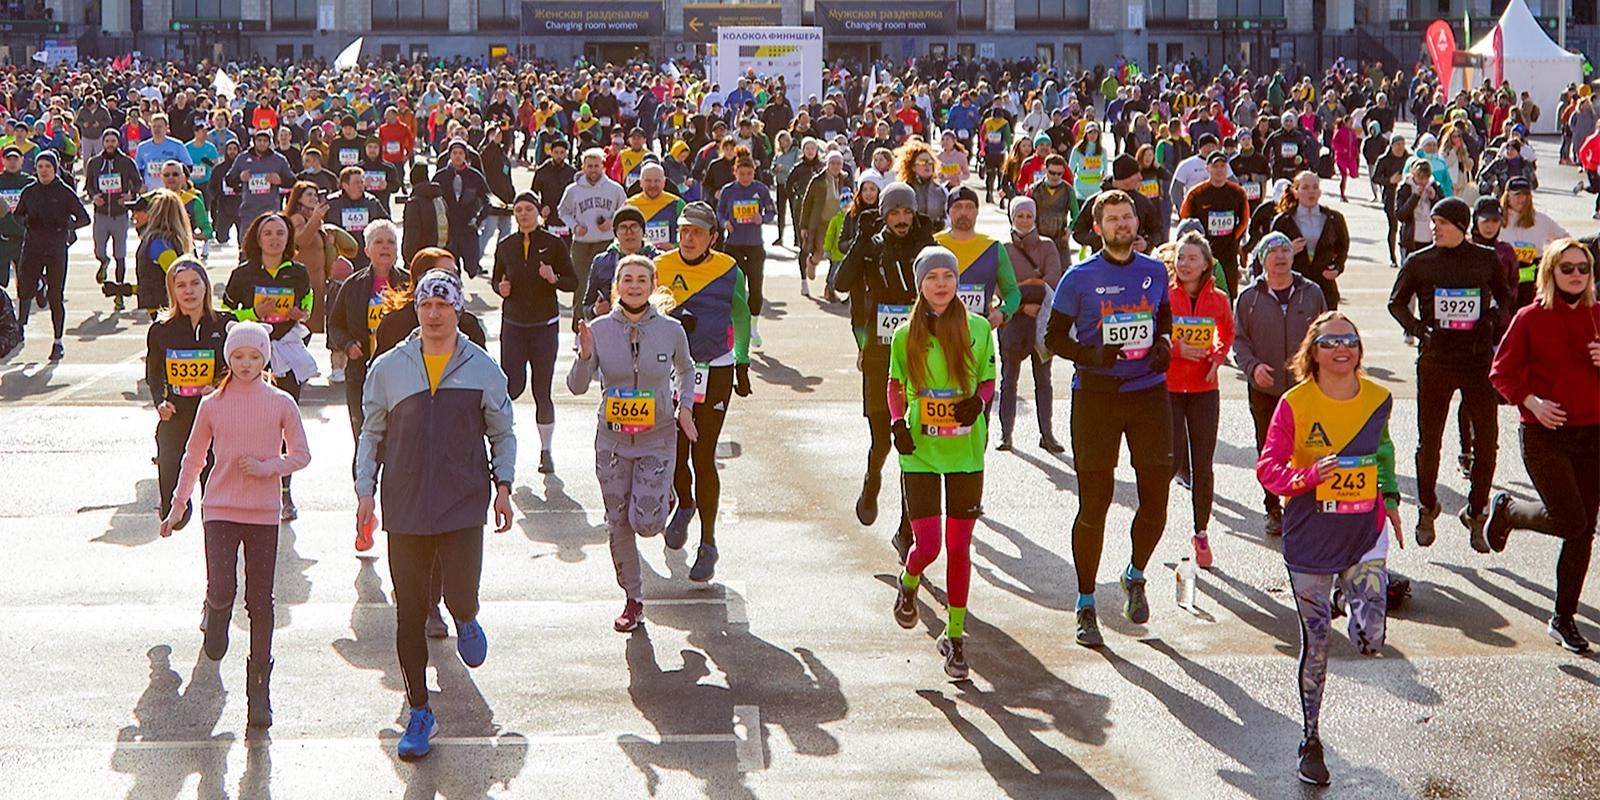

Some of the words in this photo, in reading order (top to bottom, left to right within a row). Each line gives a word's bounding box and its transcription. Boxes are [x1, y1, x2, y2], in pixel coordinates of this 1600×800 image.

[535, 9, 582, 19] Женская
[586, 10, 648, 20] раздевалка
[829, 9, 876, 20] Мужская
[880, 10, 943, 20] раздевалка
[545, 21, 583, 31] Changing
[846, 21, 882, 30] Changing
[723, 32, 766, 40] КОЛОКОЛ
[768, 32, 820, 40] ФИНИШЕРА
[1440, 300, 1476, 312] 3929
[370, 309, 384, 320] 46
[1110, 325, 1148, 342] 5073
[1176, 328, 1210, 341] 3923
[171, 363, 208, 376] 5332
[612, 402, 648, 416] 5664
[927, 402, 956, 418] 503
[1331, 472, 1366, 490] 243
[1326, 502, 1333, 510] F
